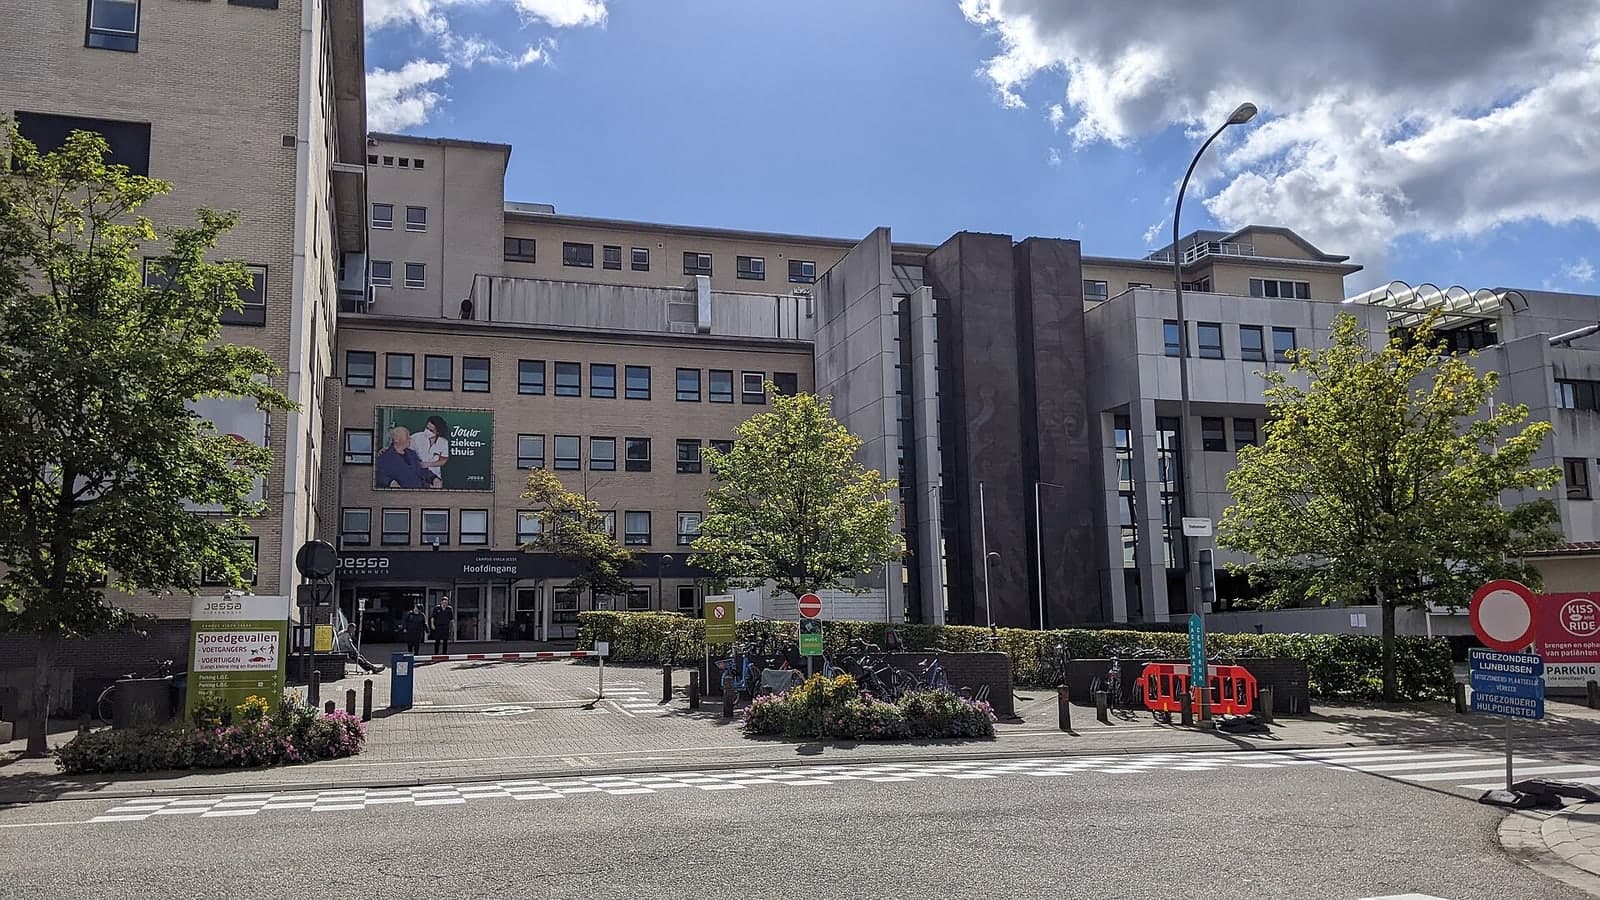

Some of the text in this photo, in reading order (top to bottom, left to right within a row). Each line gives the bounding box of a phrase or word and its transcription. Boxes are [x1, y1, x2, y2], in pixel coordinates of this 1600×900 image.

[450, 425, 480, 438] Jouw
[450, 438, 486, 447] zieken-
[450, 447, 475, 456] thuis
[463, 564, 517, 574] Hoofdingang
[1568, 604, 1594, 614] KISS
[1569, 621, 1596, 631] RIDE
[197, 633, 278, 645] Spoedgevallen
[1544, 642, 1572, 650] brengen
[1472, 651, 1540, 664] UITGEZONDERD
[1560, 649, 1598, 657] patiënten
[1479, 662, 1532, 674] LIJNBUSSEN
[1546, 666, 1596, 675] PARKING
[1476, 693, 1537, 708] UITGEZONDERD
[1476, 703, 1536, 718] HULPDIENSTEN
